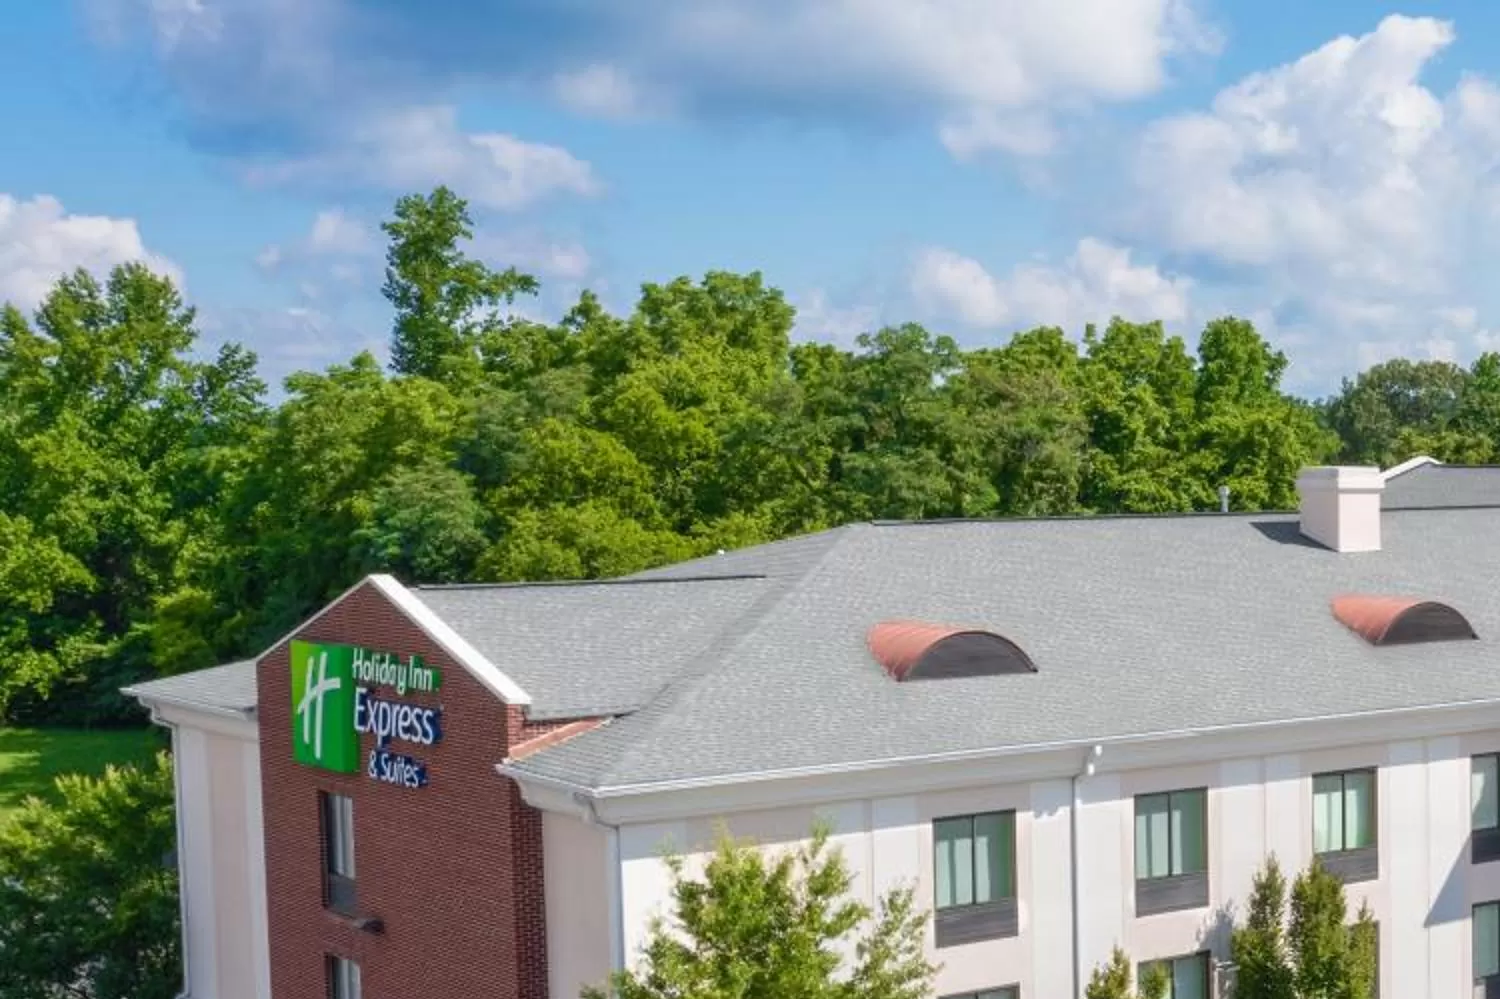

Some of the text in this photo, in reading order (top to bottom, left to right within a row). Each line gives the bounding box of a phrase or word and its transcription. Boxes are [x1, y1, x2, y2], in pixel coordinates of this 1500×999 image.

[353, 648, 433, 695] Holiday Inn
[354, 687, 433, 746] Express
[368, 750, 419, 787] & Suites
